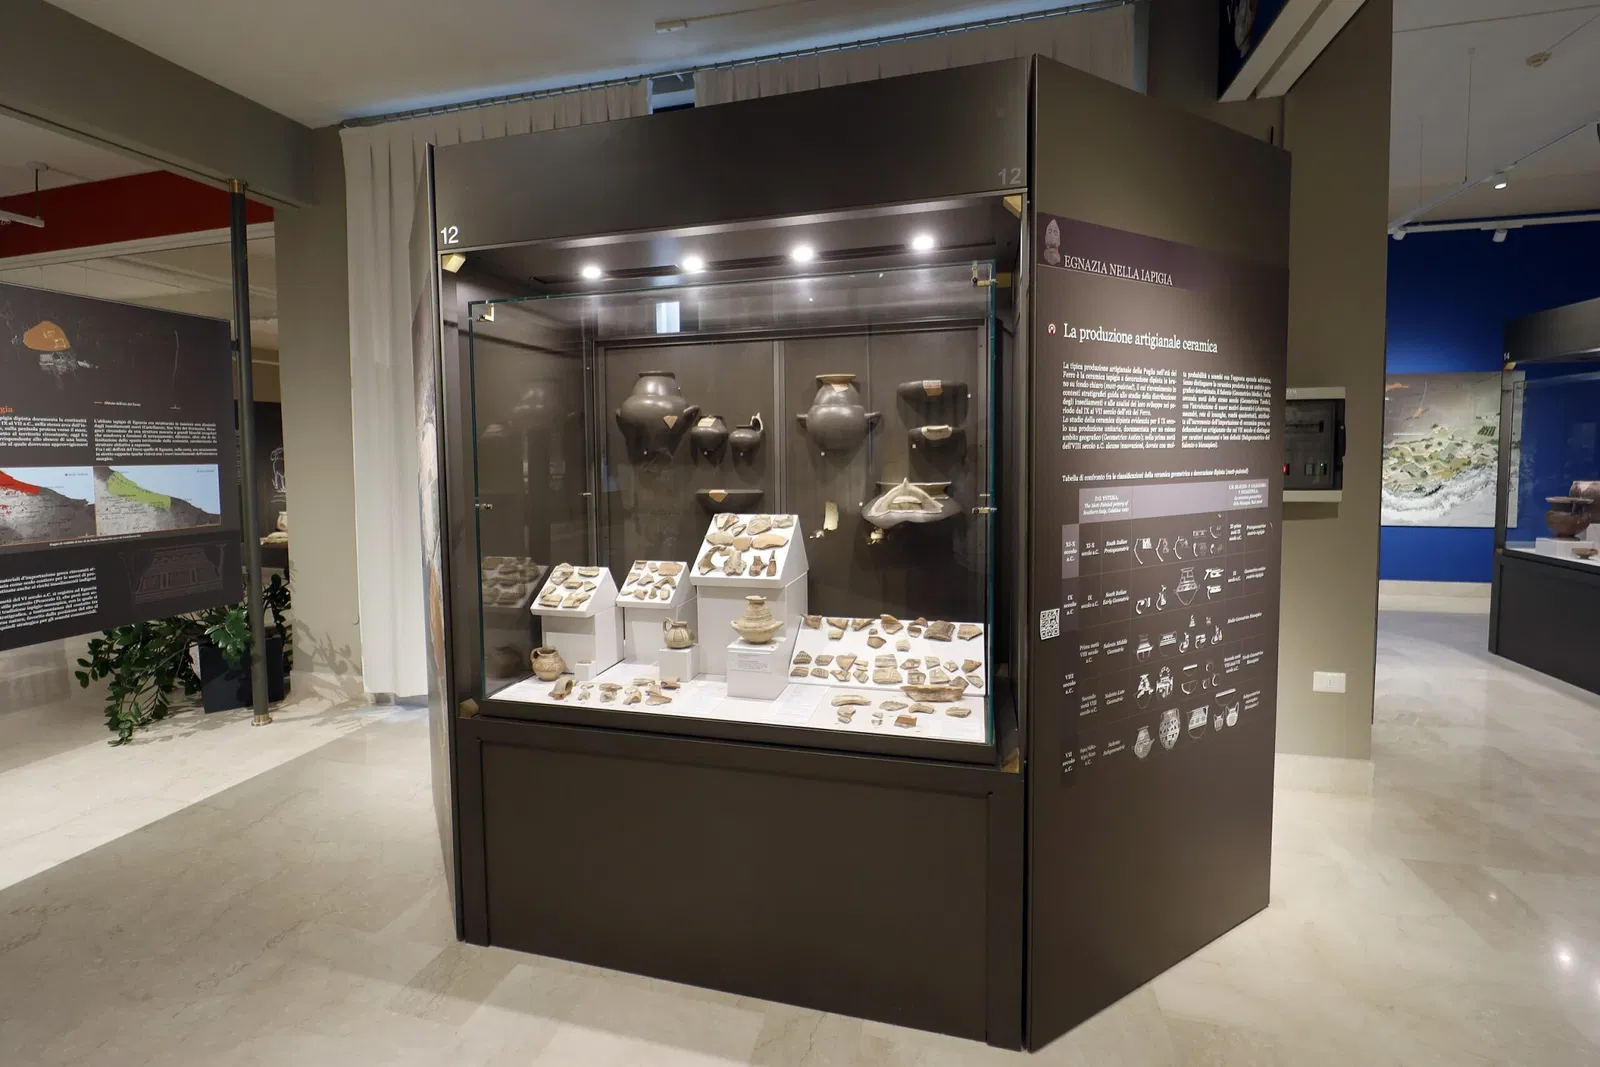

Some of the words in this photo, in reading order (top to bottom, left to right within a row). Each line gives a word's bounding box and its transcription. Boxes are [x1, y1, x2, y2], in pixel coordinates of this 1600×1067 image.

[998, 167, 1022, 185] 12
[440, 226, 458, 244] 12
[1064, 255, 1108, 274] EGNAZIA
[1109, 263, 1140, 280] NELLA
[1141, 269, 1173, 286] IAPIGIA
[1064, 323, 1077, 338] La
[1079, 326, 1132, 344] produzione
[1134, 333, 1181, 350] artigianale
[1182, 339, 1218, 353] ceramica
[1084, 364, 1108, 372] produzione
[1078, 425, 1103, 433] produzione
